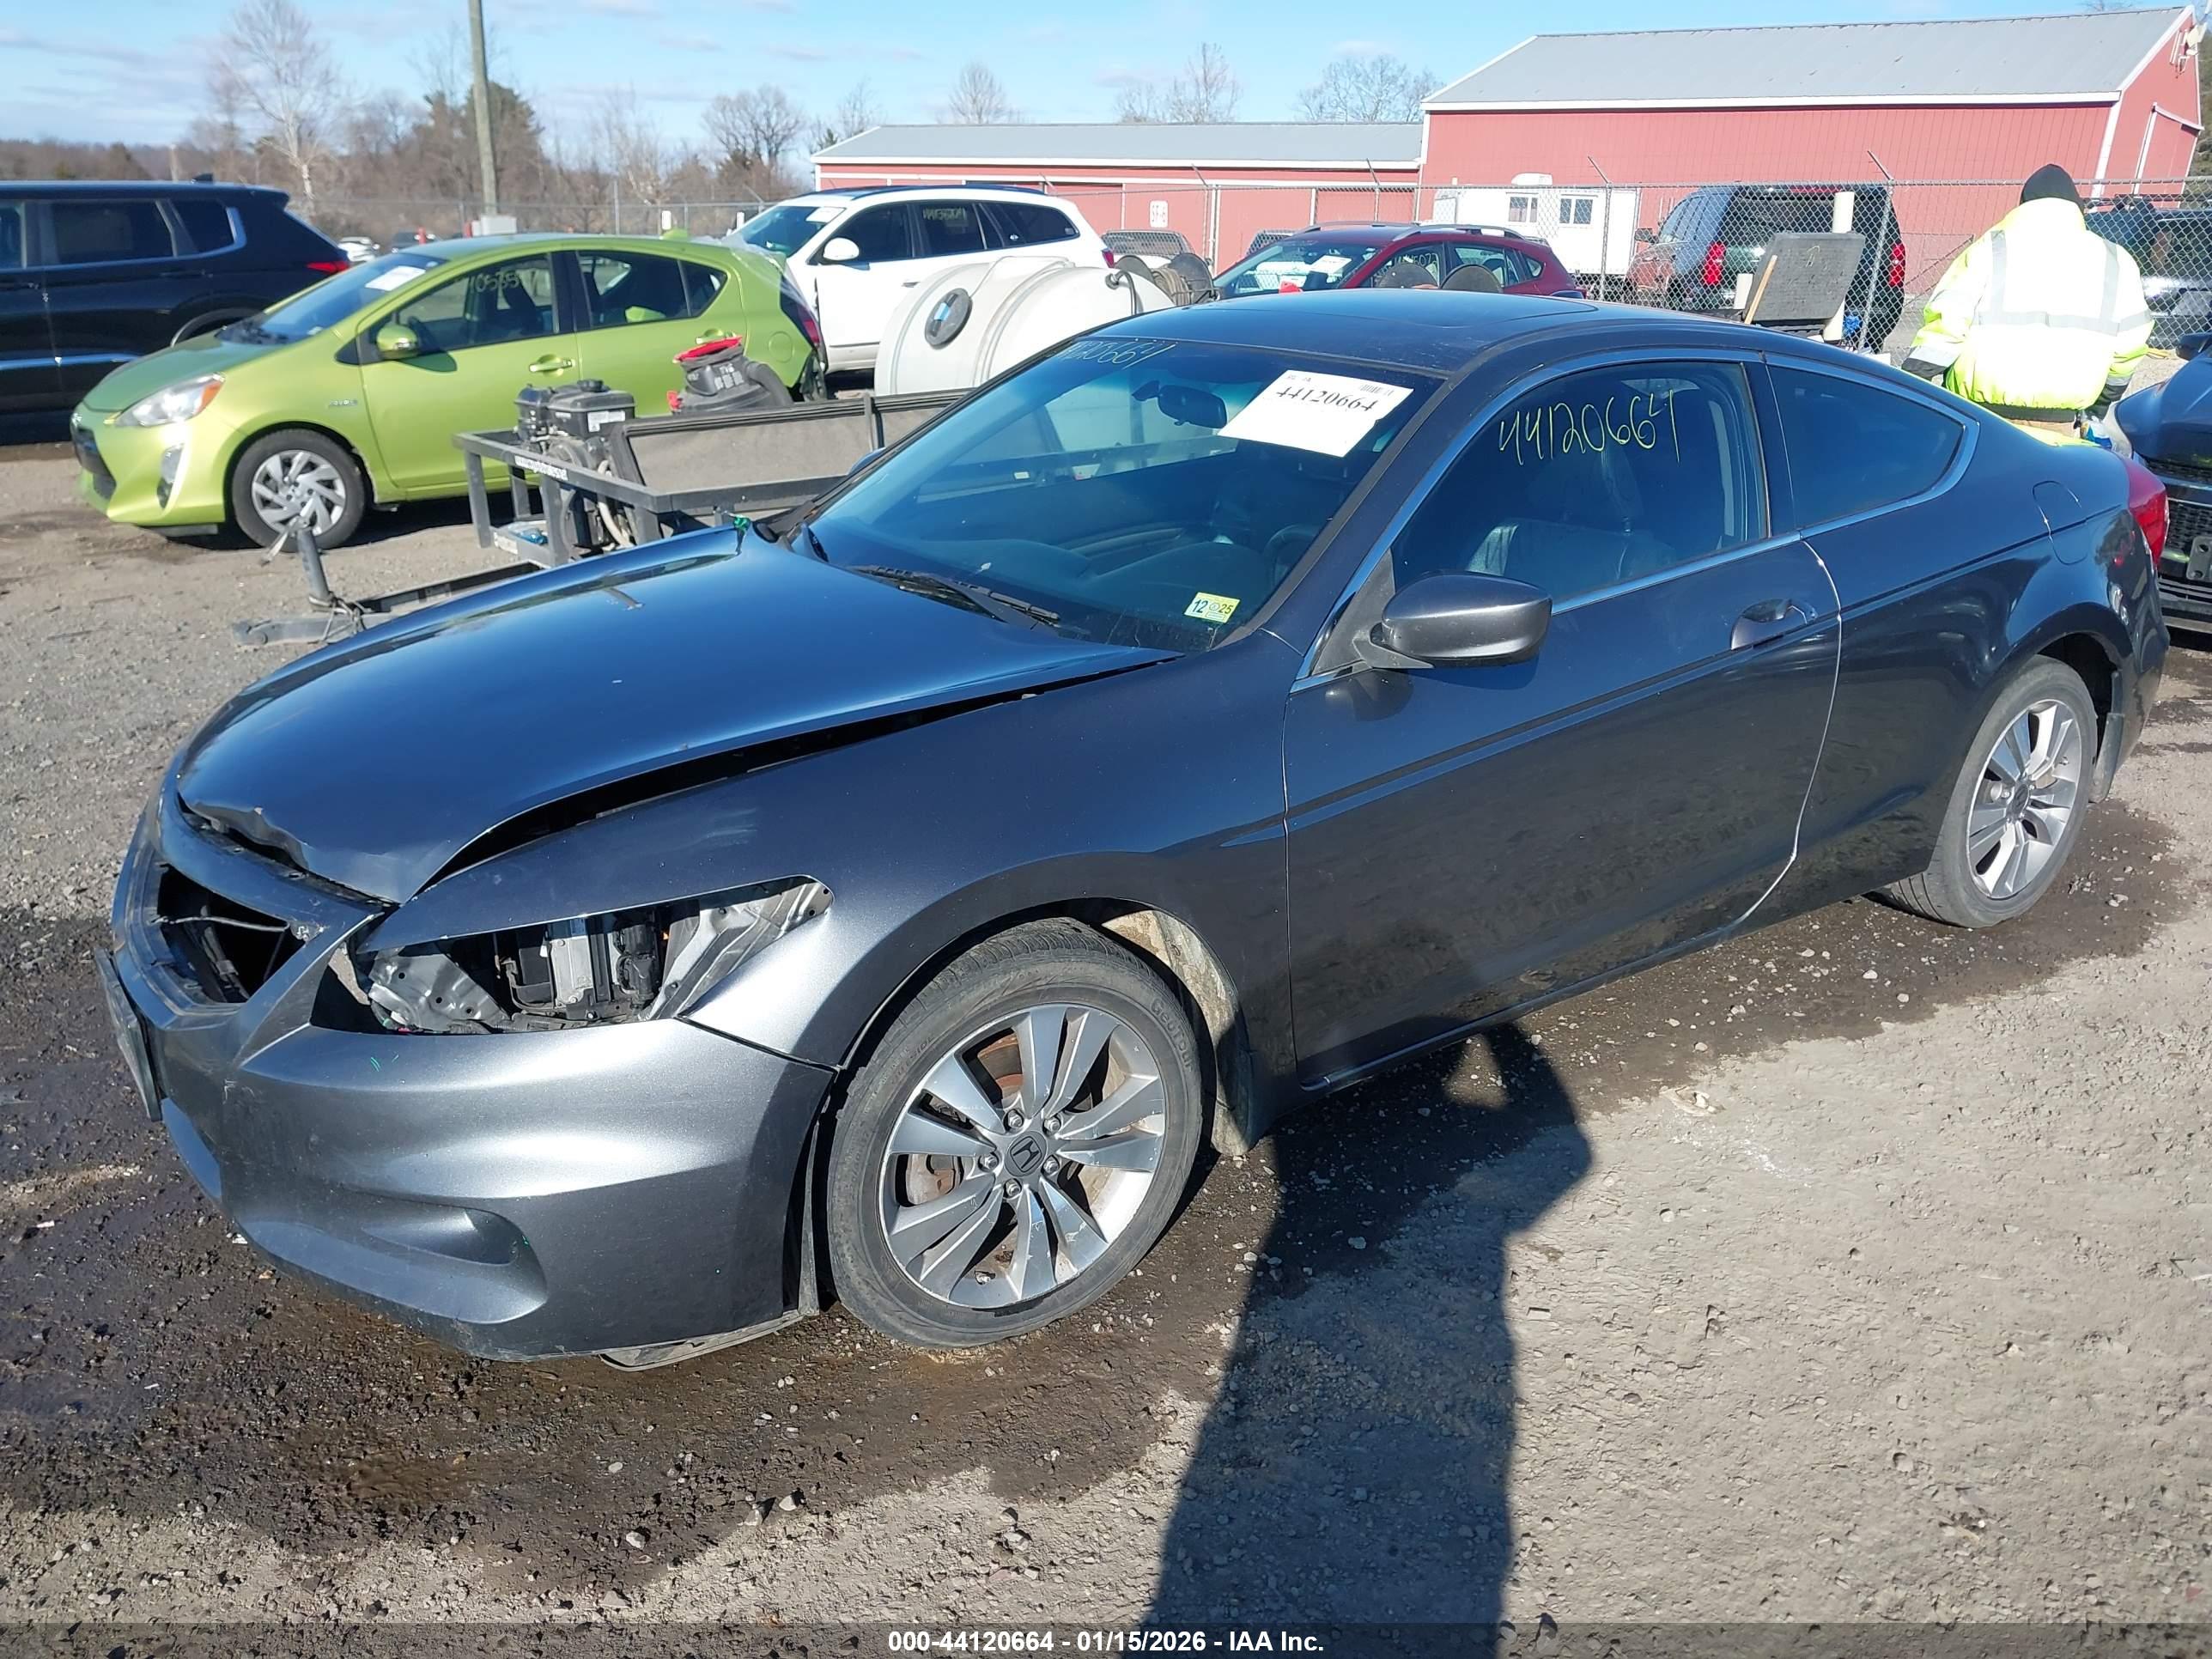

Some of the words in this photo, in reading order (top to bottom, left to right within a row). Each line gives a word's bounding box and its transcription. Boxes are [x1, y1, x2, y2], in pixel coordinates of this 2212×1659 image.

[1276, 386, 1379, 412] 44120664
[1498, 389, 1680, 466] 44120664
[1193, 599, 1209, 614] 12
[1217, 603, 1234, 615] 25
